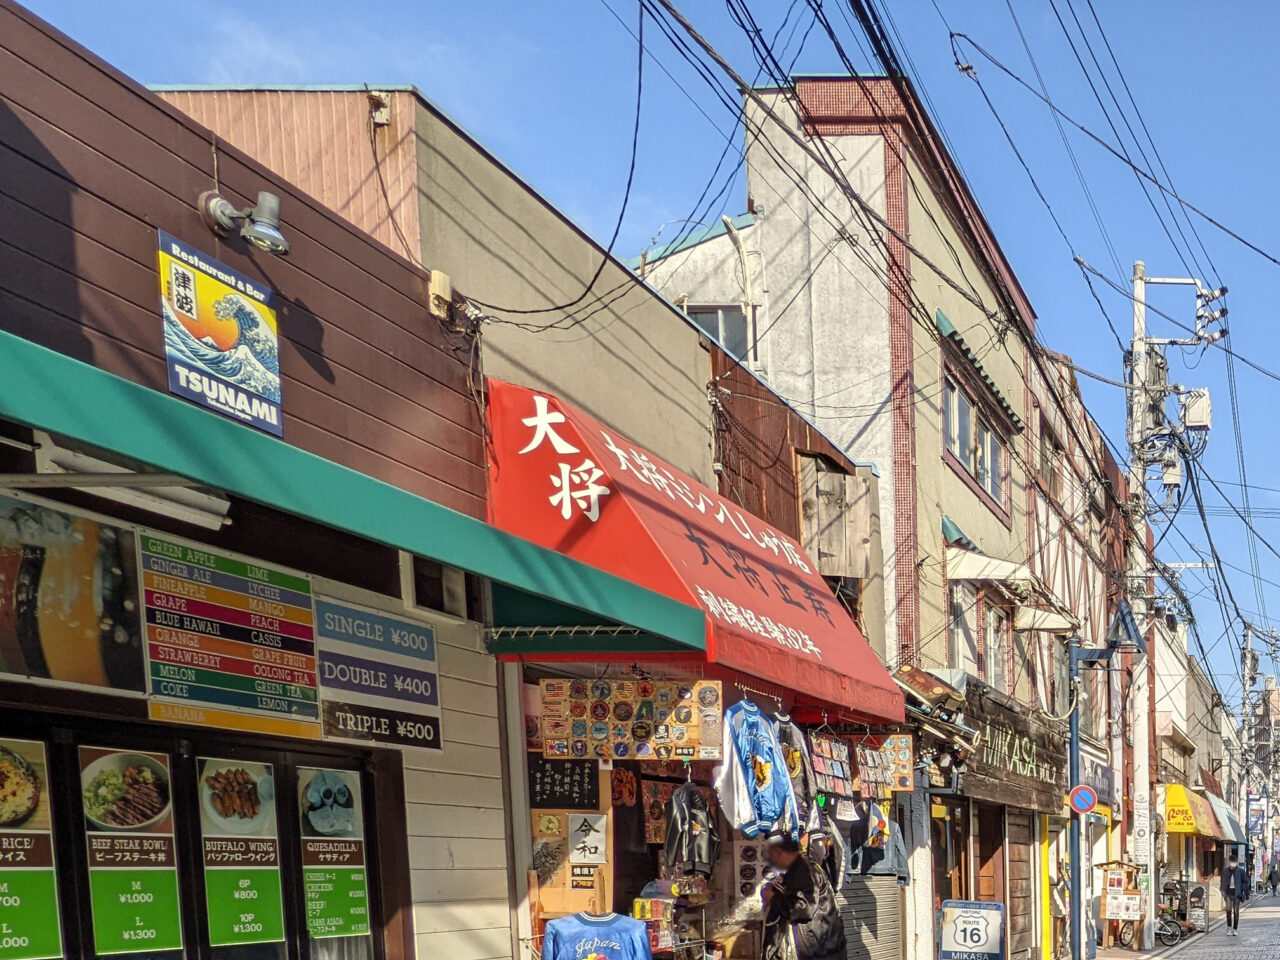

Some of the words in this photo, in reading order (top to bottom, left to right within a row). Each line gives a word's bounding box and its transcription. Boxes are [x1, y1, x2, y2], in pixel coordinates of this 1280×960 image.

[170, 243, 236, 288] Restaurant
[237, 280, 245, 291] &
[245, 283, 265, 301] Bar
[174, 267, 194, 317] 津波
[174, 363, 279, 426] TSUNAMI
[518, 395, 611, 522] 大将
[149, 539, 182, 560] GREEN
[187, 549, 216, 568] APPLE
[150, 558, 188, 578] GINGER
[193, 569, 212, 583] ALE
[247, 566, 269, 581] LIME
[153, 575, 207, 599] PINEAPPLE
[248, 582, 281, 601] LYCHEE
[153, 593, 187, 612] GRAPE
[249, 599, 285, 617] MANGO
[155, 611, 181, 626] BLUE
[183, 616, 221, 635] HAWAII
[250, 614, 280, 631] PEACH
[155, 628, 200, 647] ORANGE
[251, 631, 282, 647] CASSIS
[324, 612, 384, 642] SINGLE
[390, 627, 428, 652] ¥300
[158, 647, 221, 668] STRAWBERRY
[252, 649, 282, 664] GRAPE
[283, 654, 307, 668] FRUIT
[159, 665, 196, 681] MELON
[253, 665, 292, 681] OOLONG
[293, 671, 310, 685] TEA
[323, 660, 387, 689] DOUBLE
[393, 674, 431, 697] ¥400
[160, 682, 189, 697] COKE
[254, 680, 283, 695] GREEN
[285, 685, 302, 698] TEA
[160, 705, 206, 722] BANANA
[257, 697, 288, 712] LEMON
[335, 711, 390, 735] TRIPLE
[396, 720, 434, 741] ¥500
[983, 720, 1037, 777] MIKASA
[92, 839, 112, 849] BEEF
[114, 839, 141, 850] STEAK
[205, 841, 246, 851] BUFFALO
[574, 817, 601, 859] 令和
[95, 852, 167, 862] ビーフステーキ丼
[318, 854, 350, 862] ケサディア
[131, 881, 142, 890] M
[234, 890, 258, 899] ¥800
[0, 896, 20, 907] 00
[135, 917, 144, 926] L
[240, 914, 255, 922] 10P
[2, 924, 12, 933] L
[960, 927, 981, 943] 16
[575, 937, 621, 958] Japan
[951, 952, 989, 960] MIKASA
